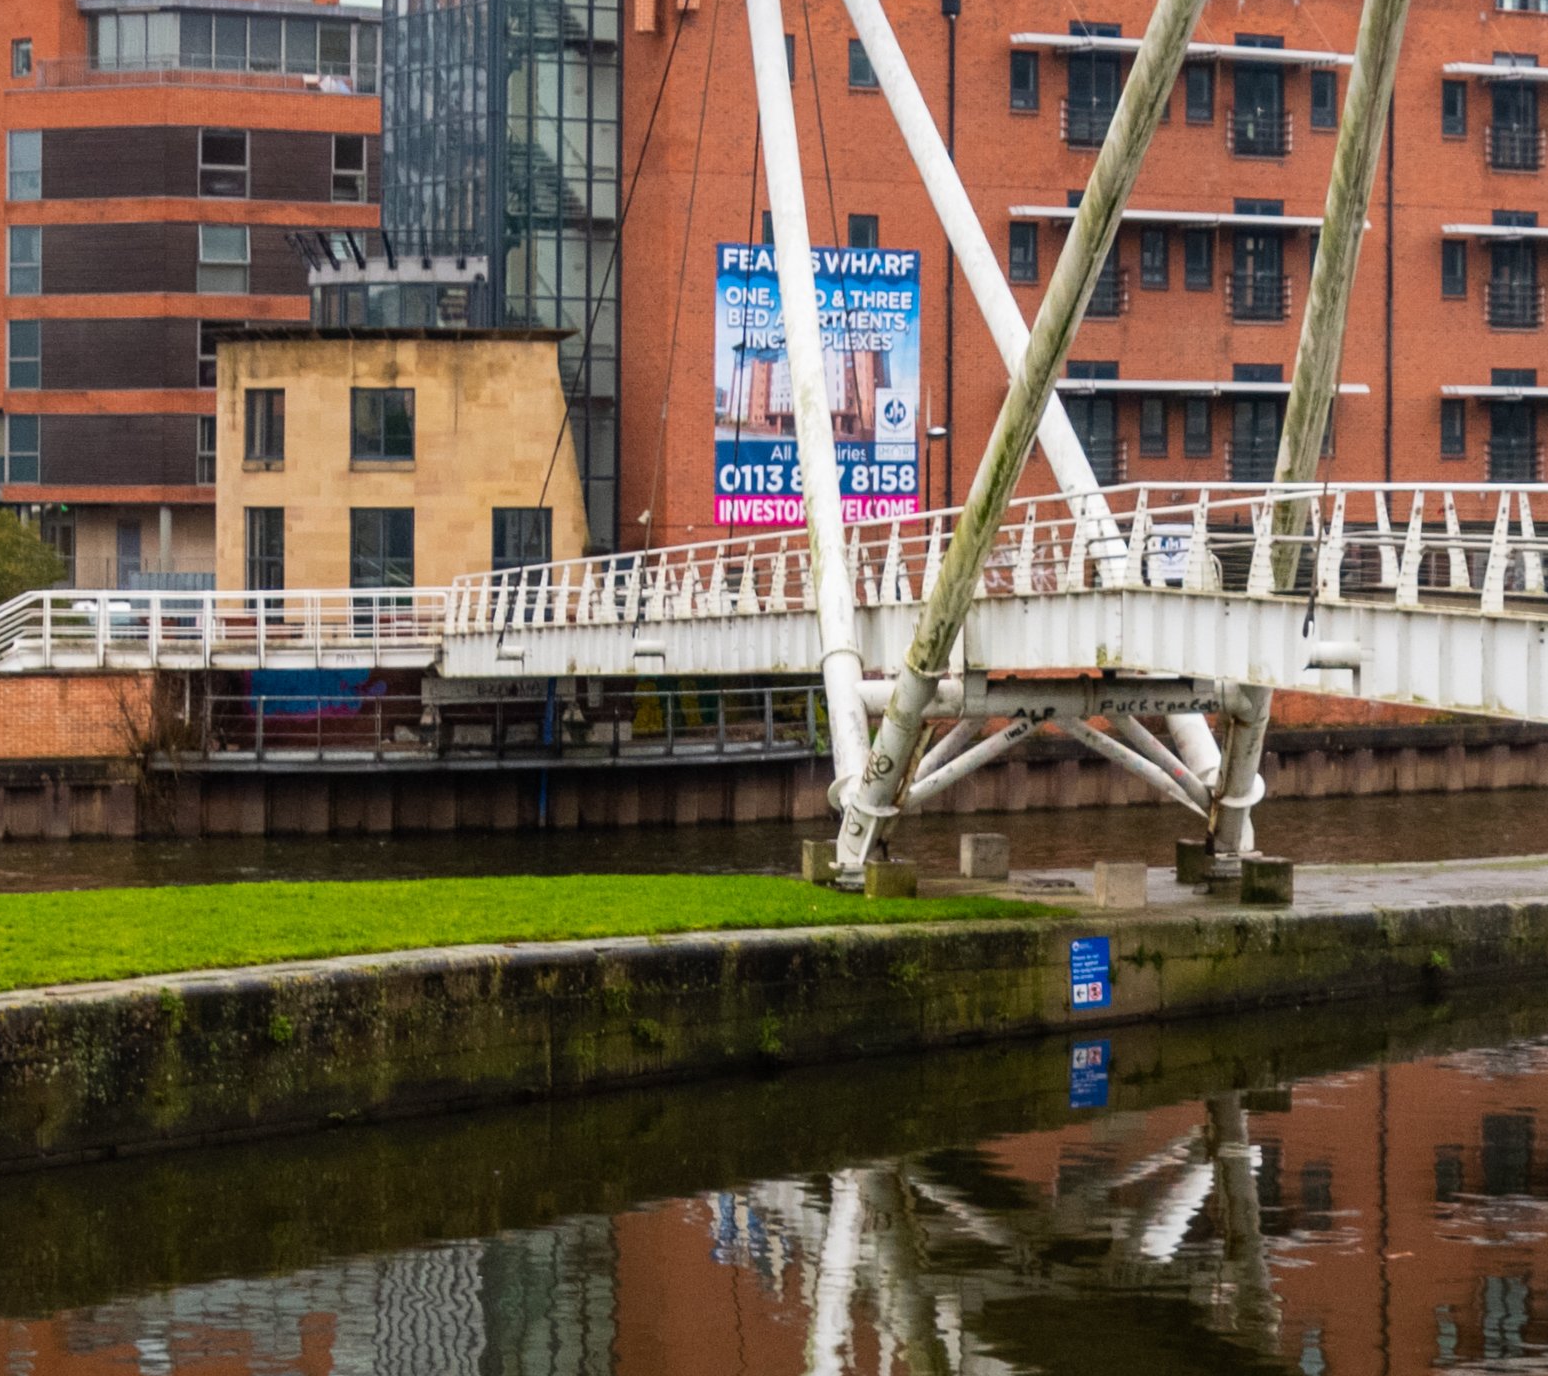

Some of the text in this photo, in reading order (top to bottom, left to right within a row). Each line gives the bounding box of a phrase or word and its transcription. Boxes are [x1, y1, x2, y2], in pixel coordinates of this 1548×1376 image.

[824, 251, 915, 276] WHARF
[725, 286, 775, 308] ONE,
[831, 290, 845, 308] &
[850, 290, 912, 310] THREE
[727, 308, 911, 332] BED ARTMENTS,
[821, 333, 893, 351] PLEXES
[770, 444, 792, 462] All
[719, 464, 784, 492] 0113
[851, 464, 916, 492] 8158
